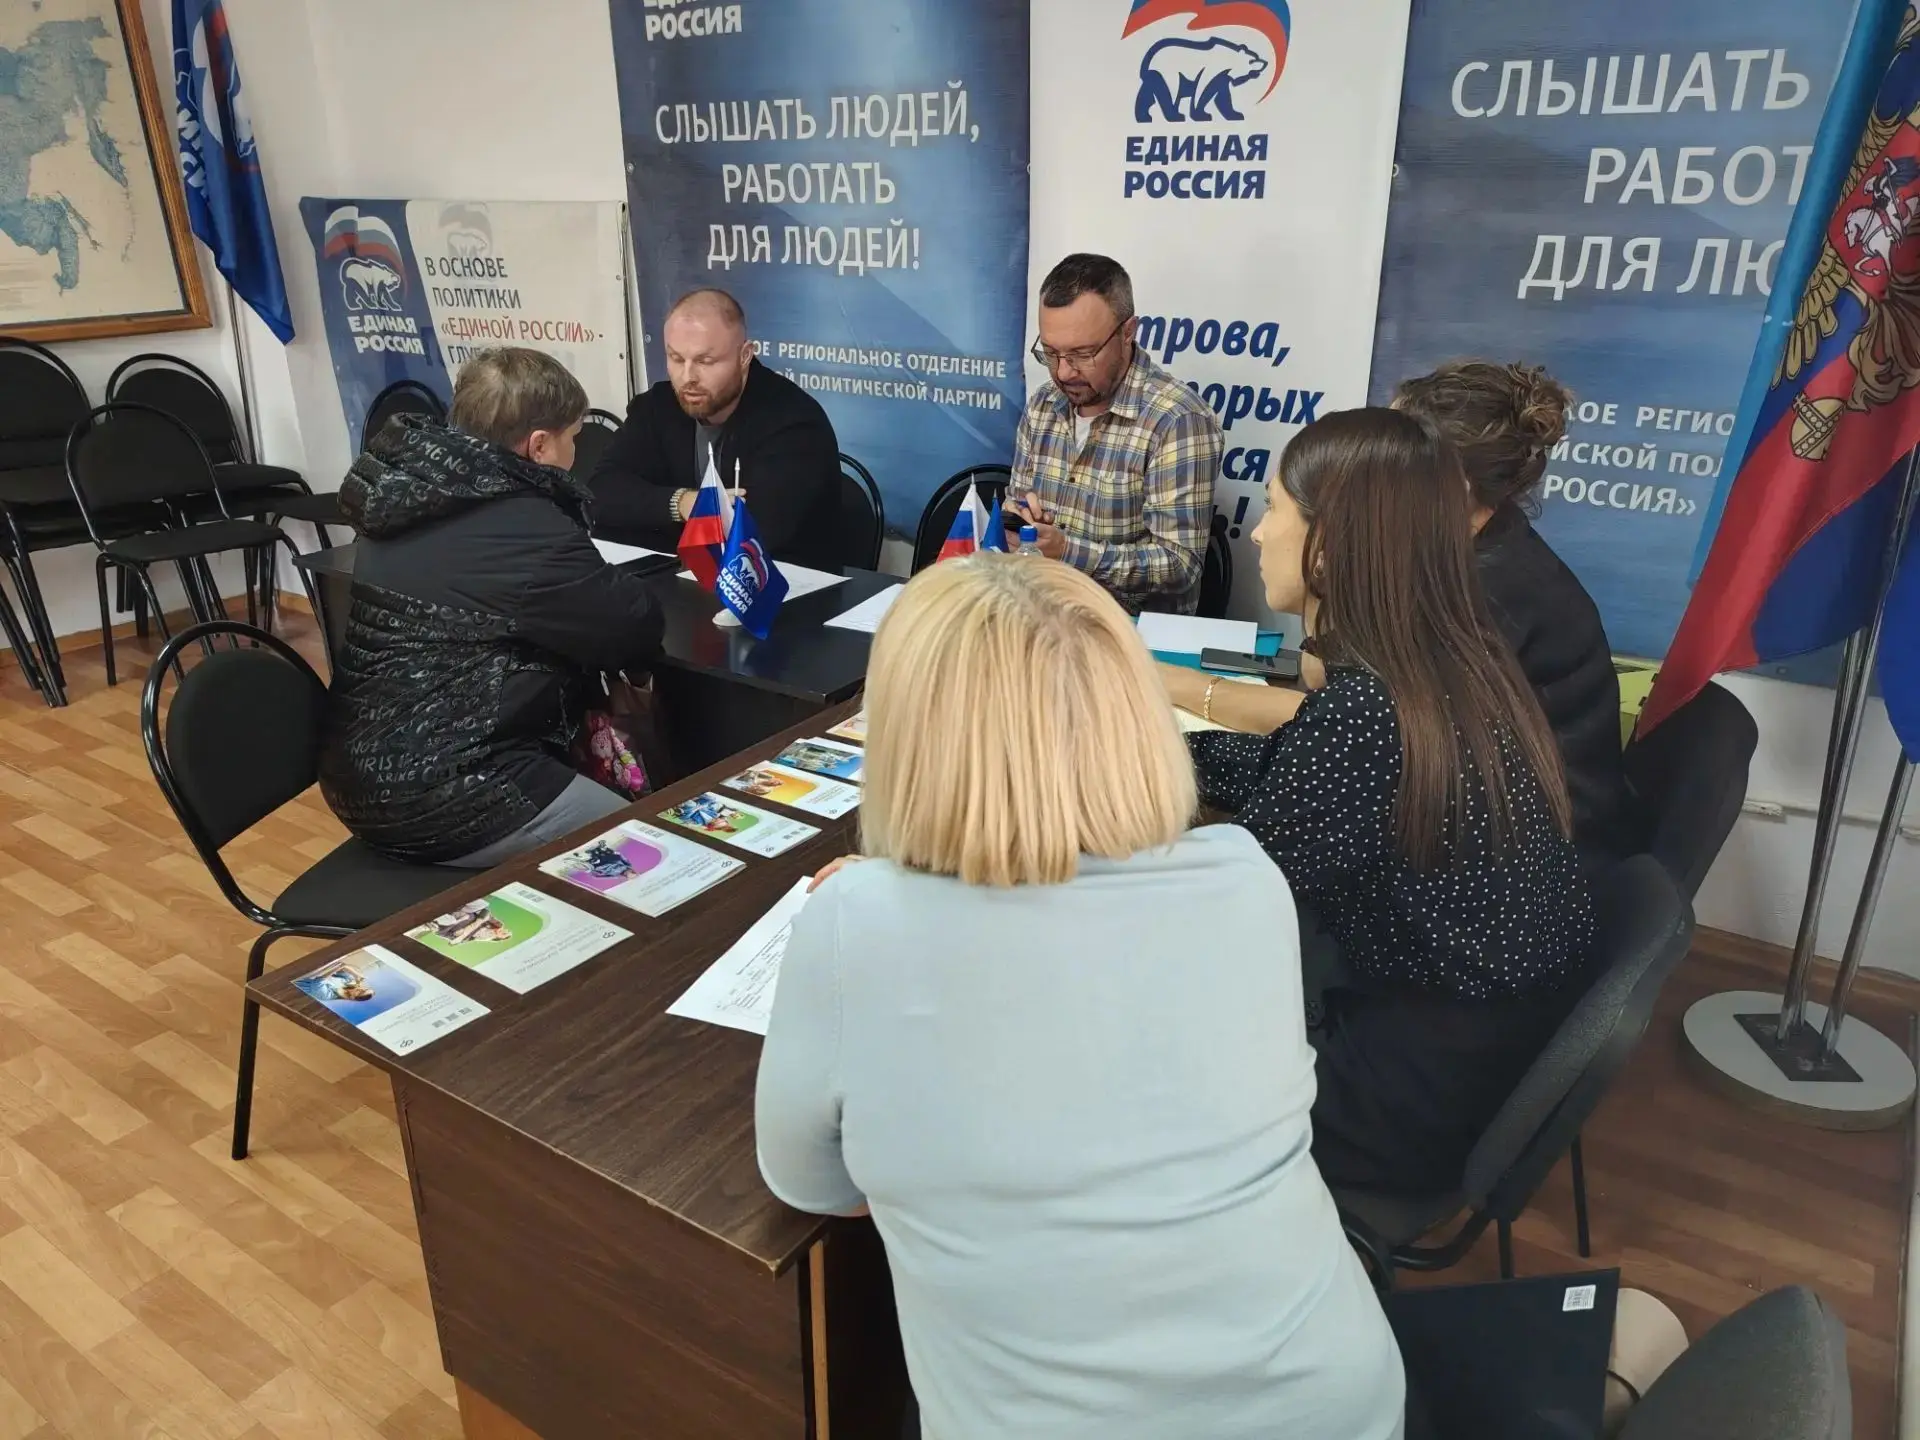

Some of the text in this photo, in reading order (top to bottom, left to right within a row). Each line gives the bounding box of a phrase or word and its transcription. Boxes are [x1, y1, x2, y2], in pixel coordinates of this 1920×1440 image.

[645, 5, 743, 41] РОССИЯ
[1451, 48, 1810, 118] СЛЫШАТЬ
[655, 80, 980, 146] СЛЫШАТЬ ЛЮДЕЙ,
[1125, 133, 1268, 165] ЕДИНАЯ
[722, 162, 896, 205] РАБОТАТЬ
[1124, 170, 1266, 200] РОССИЯ
[707, 218, 920, 276] ДЛЯ ЛЮДЕЙ!
[424, 256, 508, 279] В ОСНОВЕ
[1517, 235, 1661, 301] ДЛЯ
[432, 287, 522, 309] ПОЛИТИКИ
[347, 314, 418, 334] ЕДИНАЯ
[441, 315, 515, 341] «ЕДИНОЙ
[353, 335, 426, 355] РОССИЯ
[778, 342, 903, 369] РЕГИОНАЛЬНОЕ
[906, 353, 1006, 378] ОТДЕЛЕНИЕ
[799, 373, 928, 401] ПОЛИТИЧЕСКОЙ
[932, 387, 1001, 410] ПАРТИИ
[1543, 475, 1696, 516] РОССИЯ»
[717, 574, 748, 614] РОССИЯ
[721, 567, 753, 606] ЕДИНАЯ
